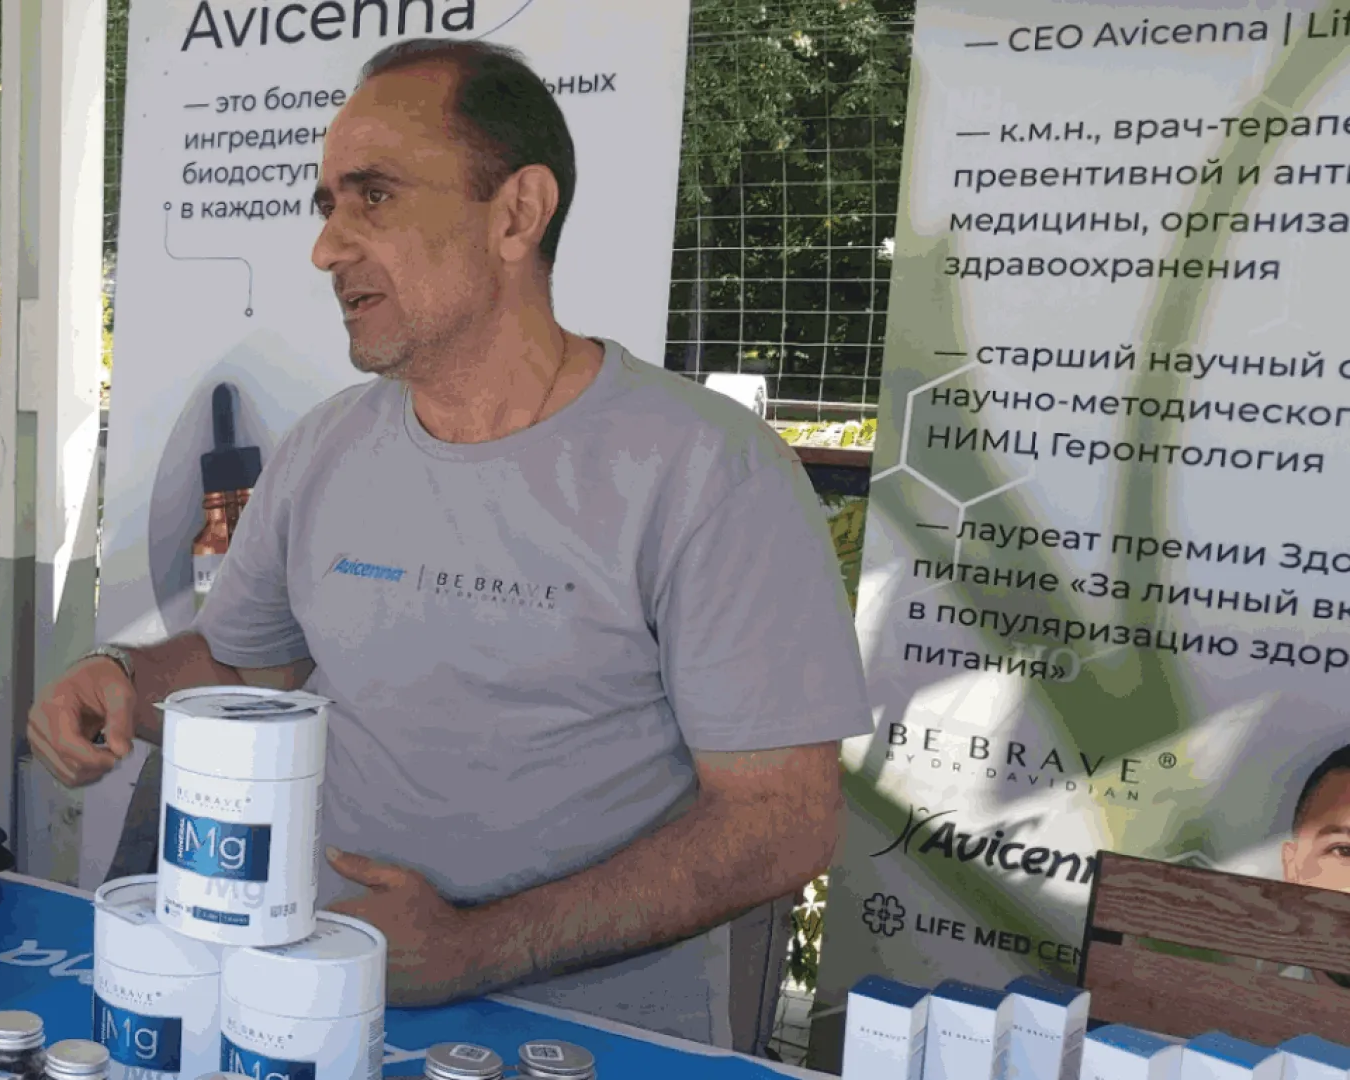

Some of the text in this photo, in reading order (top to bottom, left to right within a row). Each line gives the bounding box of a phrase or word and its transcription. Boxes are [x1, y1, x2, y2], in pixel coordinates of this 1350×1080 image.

[181, 0, 476, 51] Avicenna
[1008, 24, 1084, 52] CEO
[1094, 18, 1269, 49] Avicenna
[215, 94, 257, 114] это
[264, 86, 347, 111] более
[184, 126, 327, 154] ингредиен
[1000, 118, 1101, 145] к.м.н.,
[182, 161, 319, 187] биодоступ
[953, 160, 1350, 194] превентивной и ант
[181, 201, 194, 219] в
[201, 199, 301, 220] каждом
[950, 210, 1350, 238] медицины, организа
[944, 254, 1281, 284] здравоохранения
[976, 344, 1136, 373] старший
[1149, 350, 1326, 381] научный
[931, 386, 1350, 429] научно-методическог
[927, 424, 1325, 474] НИМЦ Геронтология
[956, 520, 1101, 554] лауреат
[1111, 532, 1265, 566] премии
[1279, 543, 1350, 575] Здо
[436, 572, 464, 589] BE
[913, 557, 1059, 593] питание
[1070, 573, 1131, 599] «За
[1143, 582, 1298, 617] личный
[908, 601, 1350, 674] в популяризацию здор
[904, 641, 1066, 682] питания»
[888, 722, 943, 752] BE
[886, 750, 915, 763] BY
[986, 767, 1140, 802] DAVIDIAN
[186, 820, 247, 869] Mg
[915, 914, 966, 942] LIFE
[974, 927, 1032, 955] MED
[106, 1009, 158, 1060] Mg
[235, 1051, 290, 1080] M
